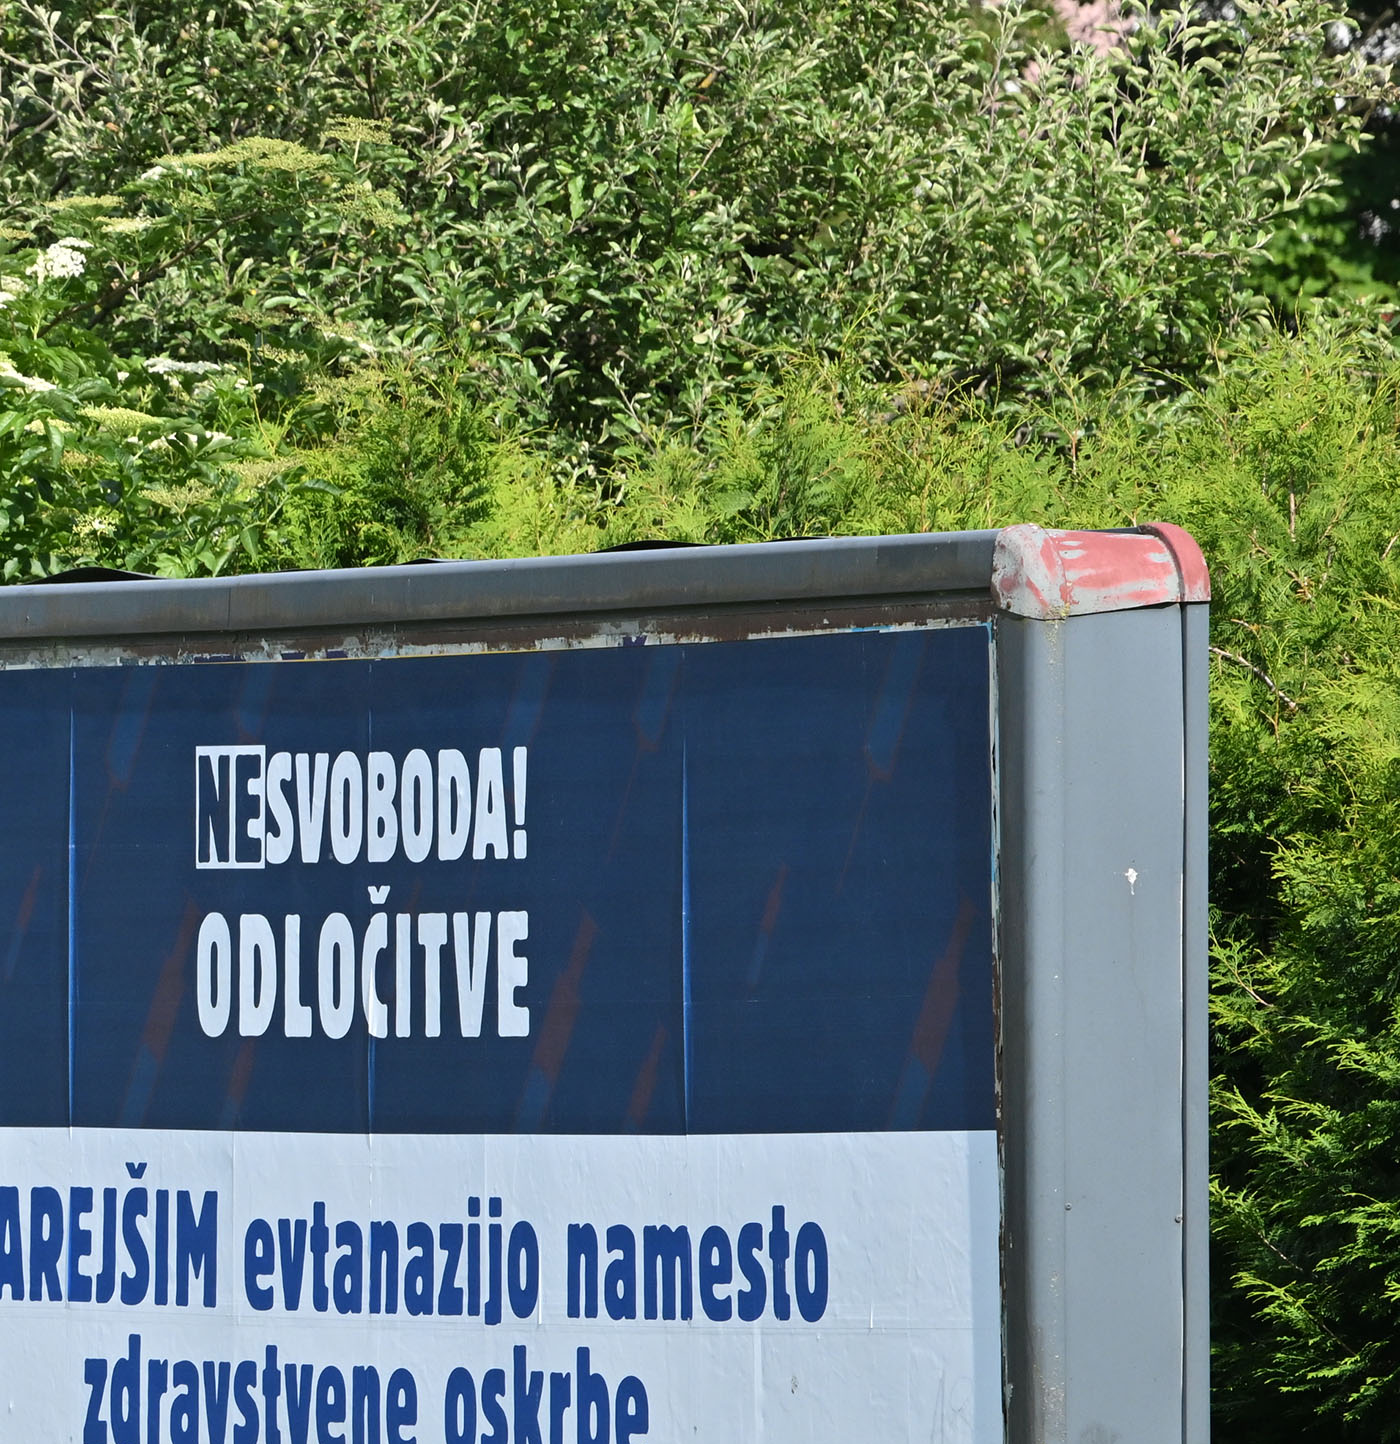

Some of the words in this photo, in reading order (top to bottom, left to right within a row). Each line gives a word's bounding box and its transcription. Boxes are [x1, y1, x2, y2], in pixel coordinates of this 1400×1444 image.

[197, 885, 530, 1039] ODLOČITVE
[244, 1196, 539, 1326] evtanazijo
[567, 1205, 829, 1323] namesto
